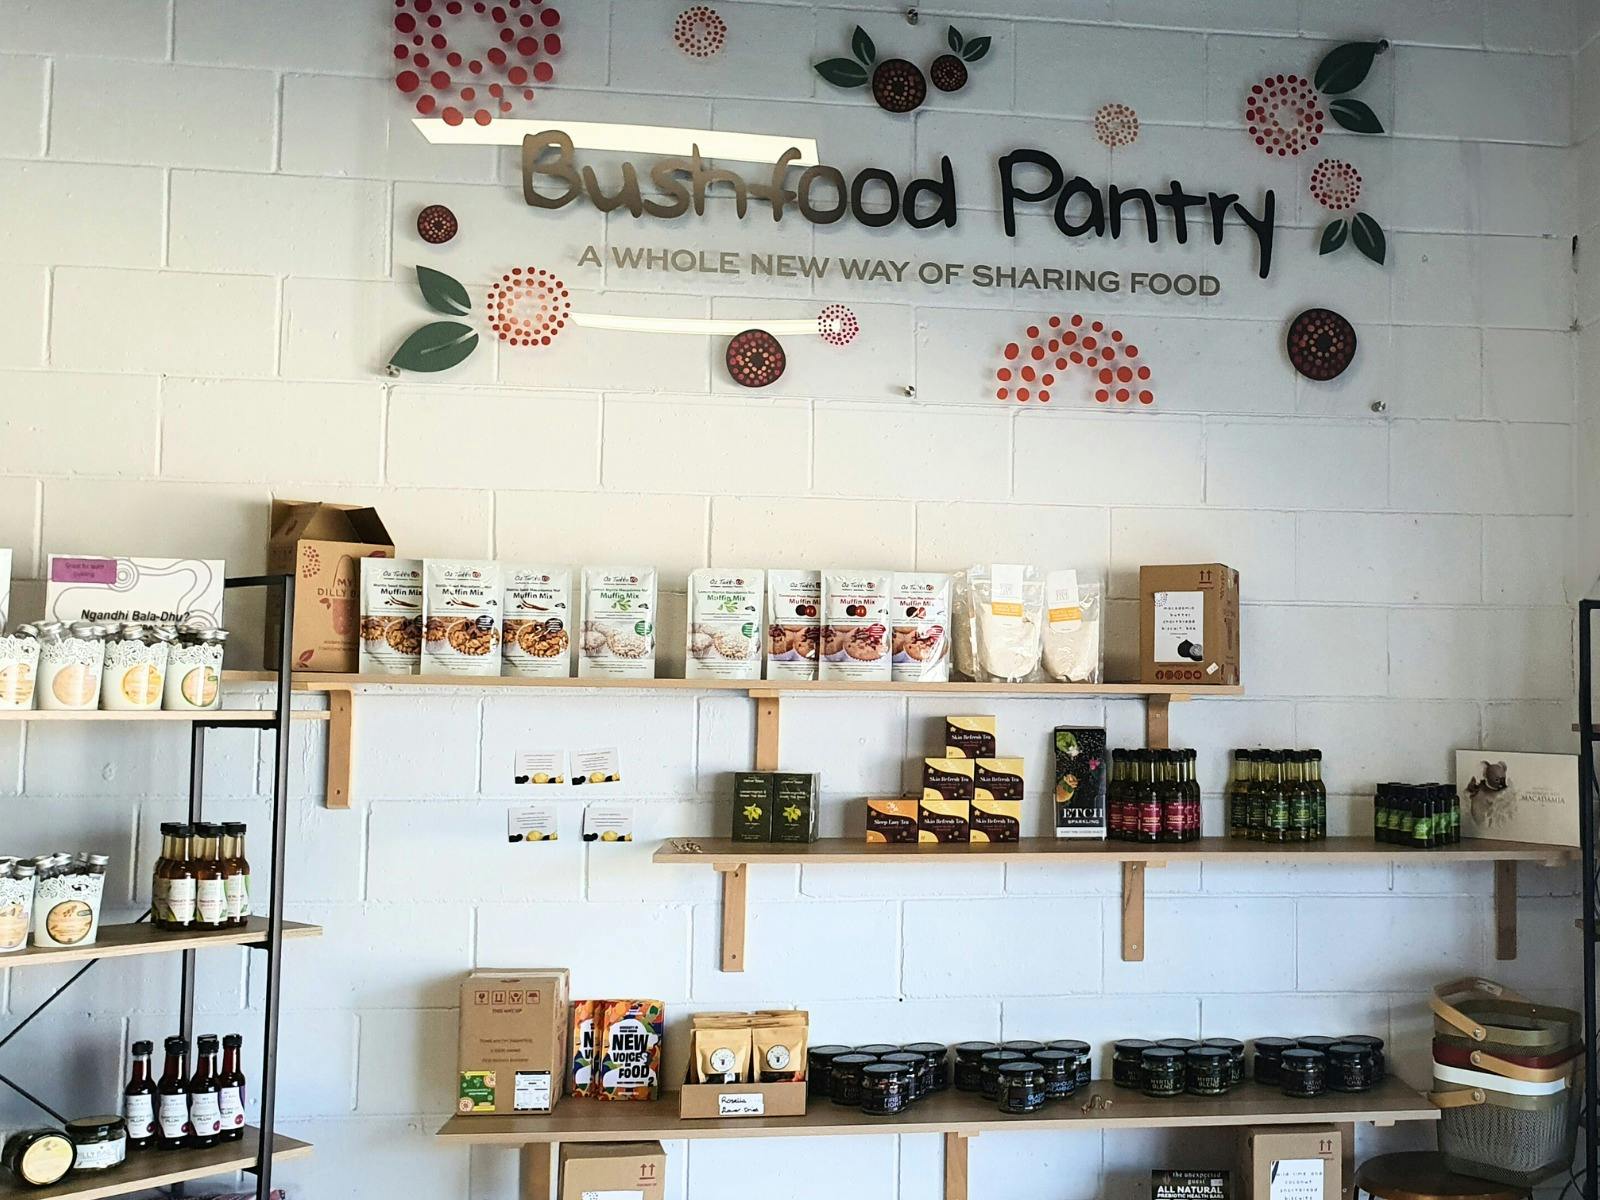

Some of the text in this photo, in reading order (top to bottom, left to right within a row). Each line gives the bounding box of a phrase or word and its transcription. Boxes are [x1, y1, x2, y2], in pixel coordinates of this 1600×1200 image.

[522, 129, 1276, 280] Bushfood Pantry
[576, 245, 1221, 297] A WHOLE NEW WAY OF SHARING FOOD
[317, 587, 347, 597] DILLY
[380, 588, 407, 597] Muffin
[469, 589, 484, 597] Mix
[513, 592, 538, 600] Muffin
[626, 592, 640, 600] Mix
[81, 609, 191, 623] Ngandhi Bala-Dhu?
[612, 1033, 650, 1051] NEW
[612, 1052, 648, 1063] VOICES
[618, 1065, 650, 1079] FOOD
[648, 1076, 654, 1087] 2
[1157, 1185, 1223, 1194] ALL NATURAL
